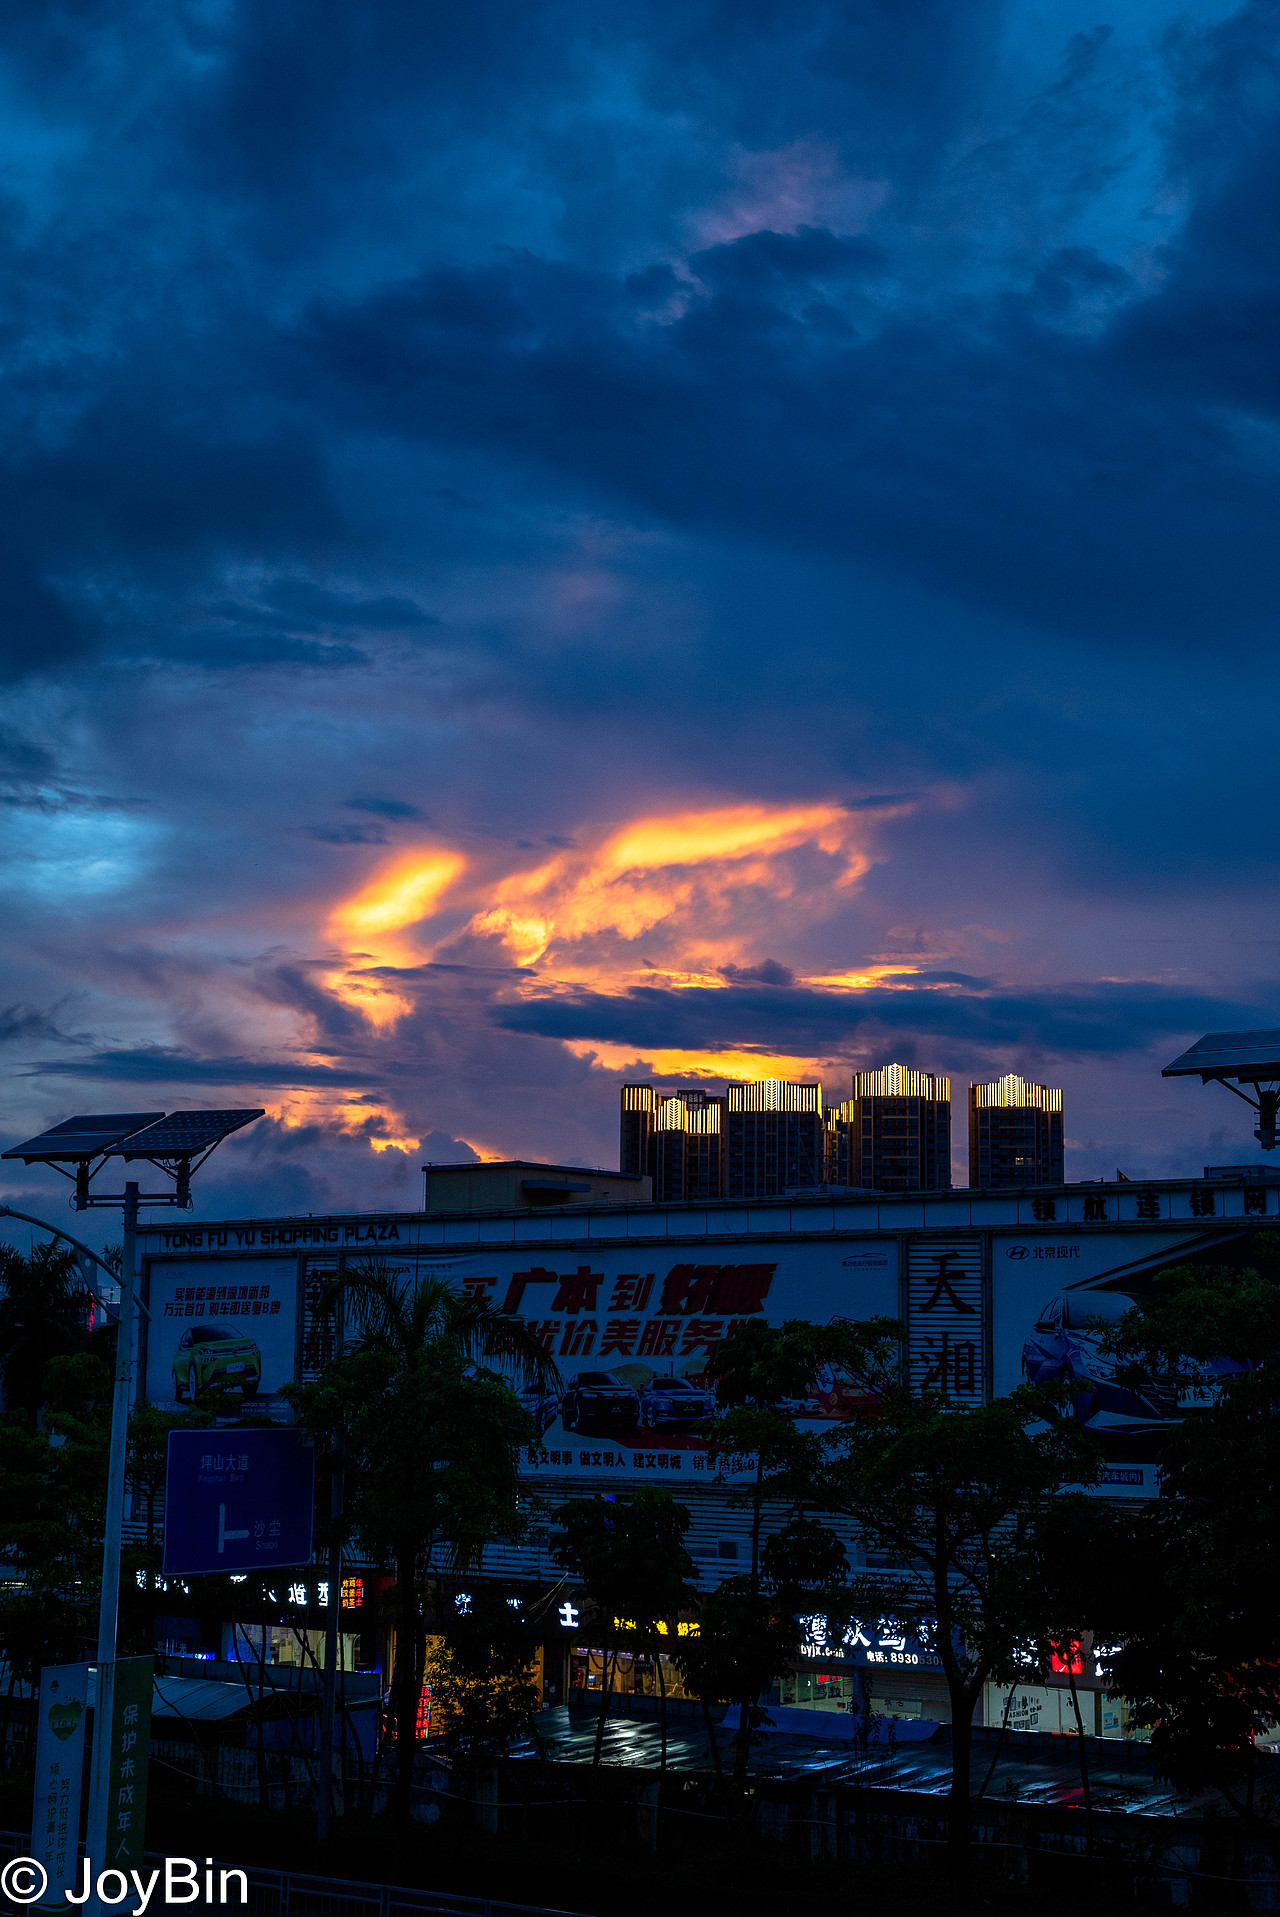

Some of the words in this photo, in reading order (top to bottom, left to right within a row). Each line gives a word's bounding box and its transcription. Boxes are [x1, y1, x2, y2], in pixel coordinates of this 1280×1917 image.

[1031, 1187, 1267, 1222] 领航连锁网
[163, 1232, 203, 1248] TONG
[207, 1231, 228, 1246] FU
[234, 1230, 255, 1245] YU
[260, 1227, 339, 1244] SHOPPING
[344, 1224, 401, 1241] PLAZA
[1032, 1245, 1081, 1259] 北京现代
[163, 1302, 205, 1317] 万元首付
[201, 1454, 249, 1471] 坪山大道
[579, 1451, 626, 1468] 做文明人
[632, 1452, 682, 1470] 建文明城
[114, 1703, 139, 1859] 保护未成年人
